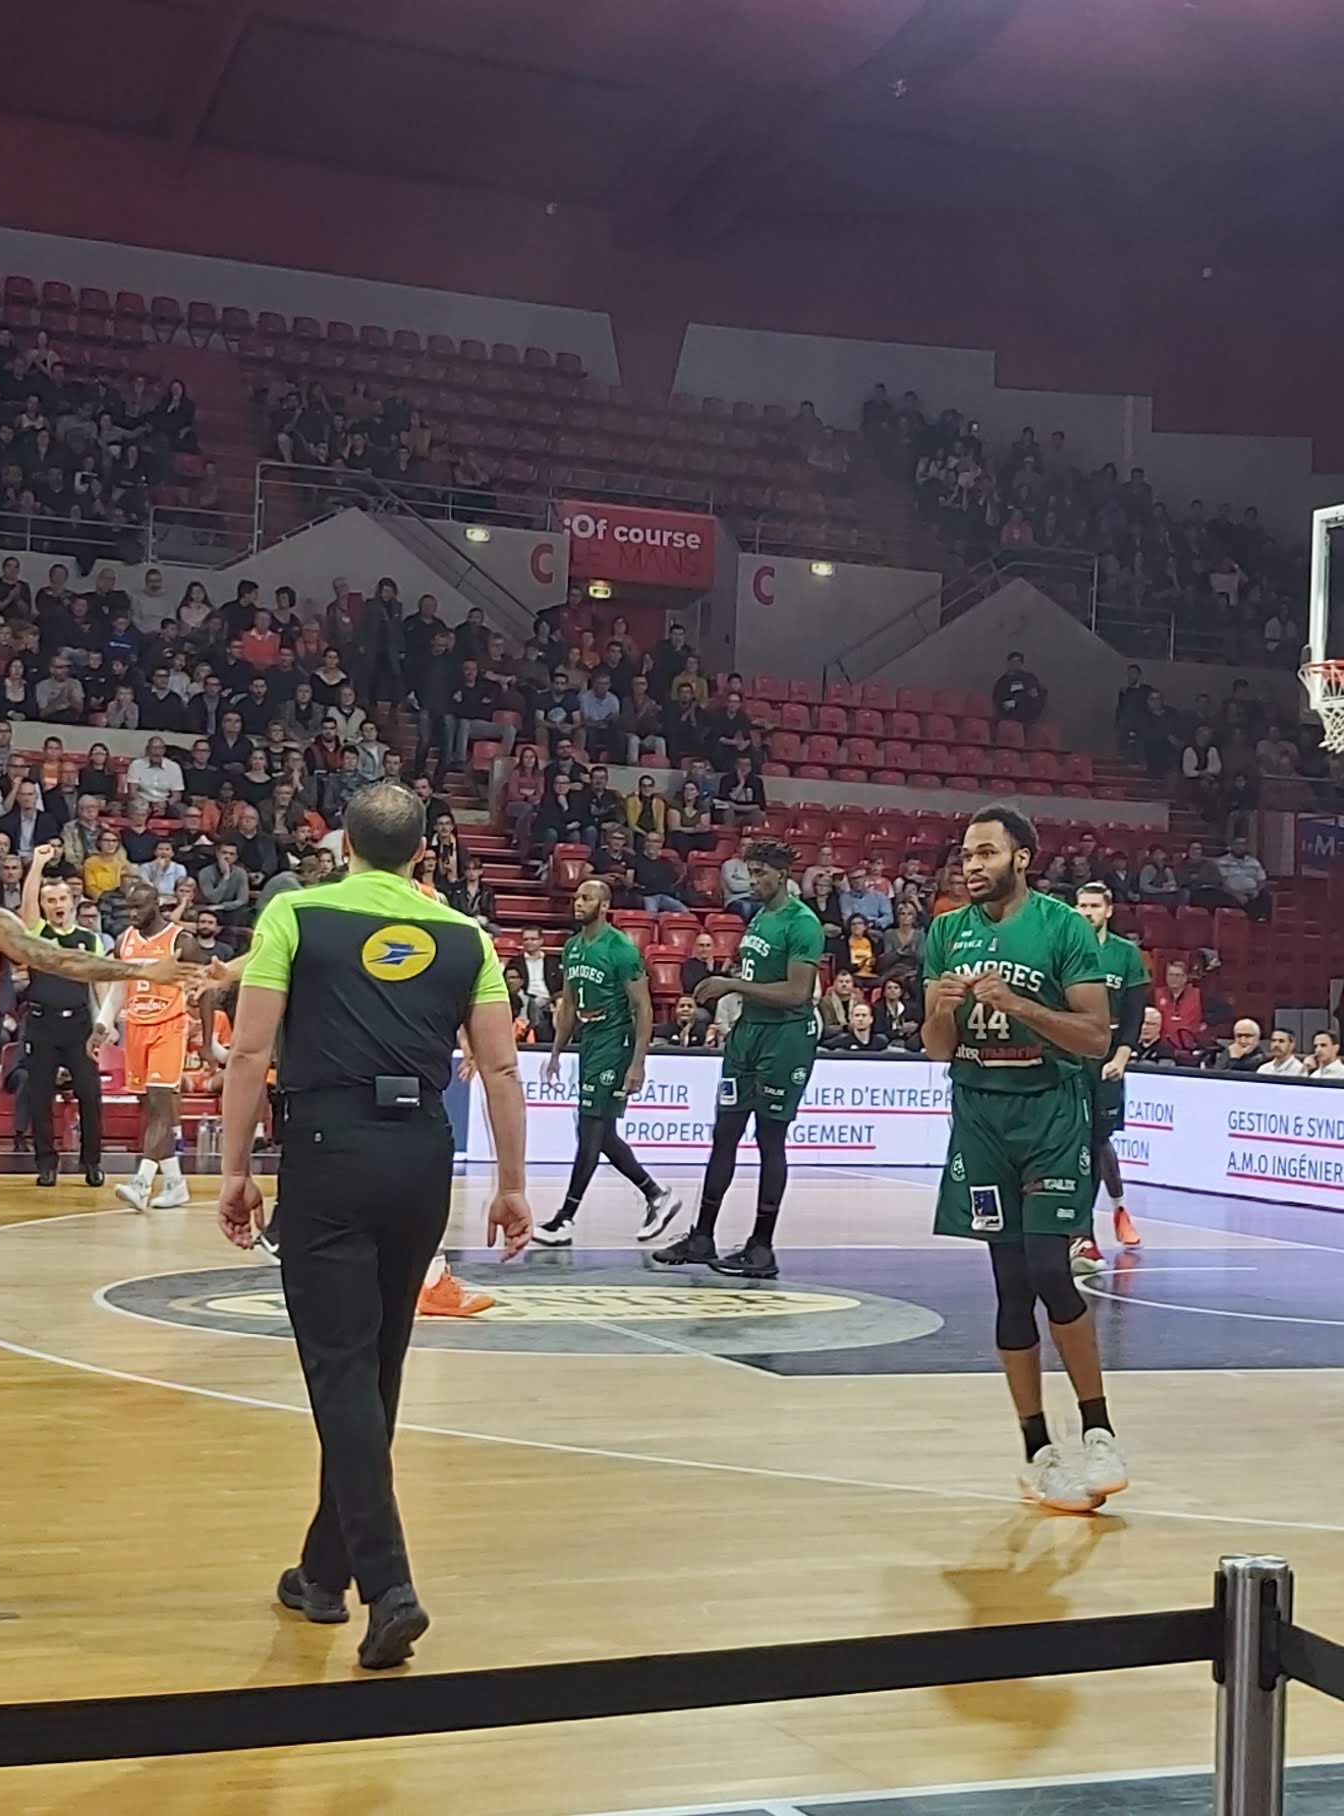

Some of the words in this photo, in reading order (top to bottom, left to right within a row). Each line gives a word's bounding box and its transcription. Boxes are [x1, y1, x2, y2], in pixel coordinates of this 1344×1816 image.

[613, 525, 701, 549] course
[530, 543, 554, 584] C
[753, 566, 775, 606] C
[741, 958, 755, 981] 16
[954, 960, 1045, 993] IMOGES
[578, 987, 585, 1008] 1
[967, 1003, 1010, 1040] 44
[631, 1080, 690, 1103] BÂTIR
[1126, 1100, 1174, 1123] CATION
[1228, 1110, 1289, 1135] GESTION
[1293, 1115, 1304, 1134] &
[625, 1122, 716, 1142] PROPERT
[1227, 1151, 1268, 1174] A.M.O
